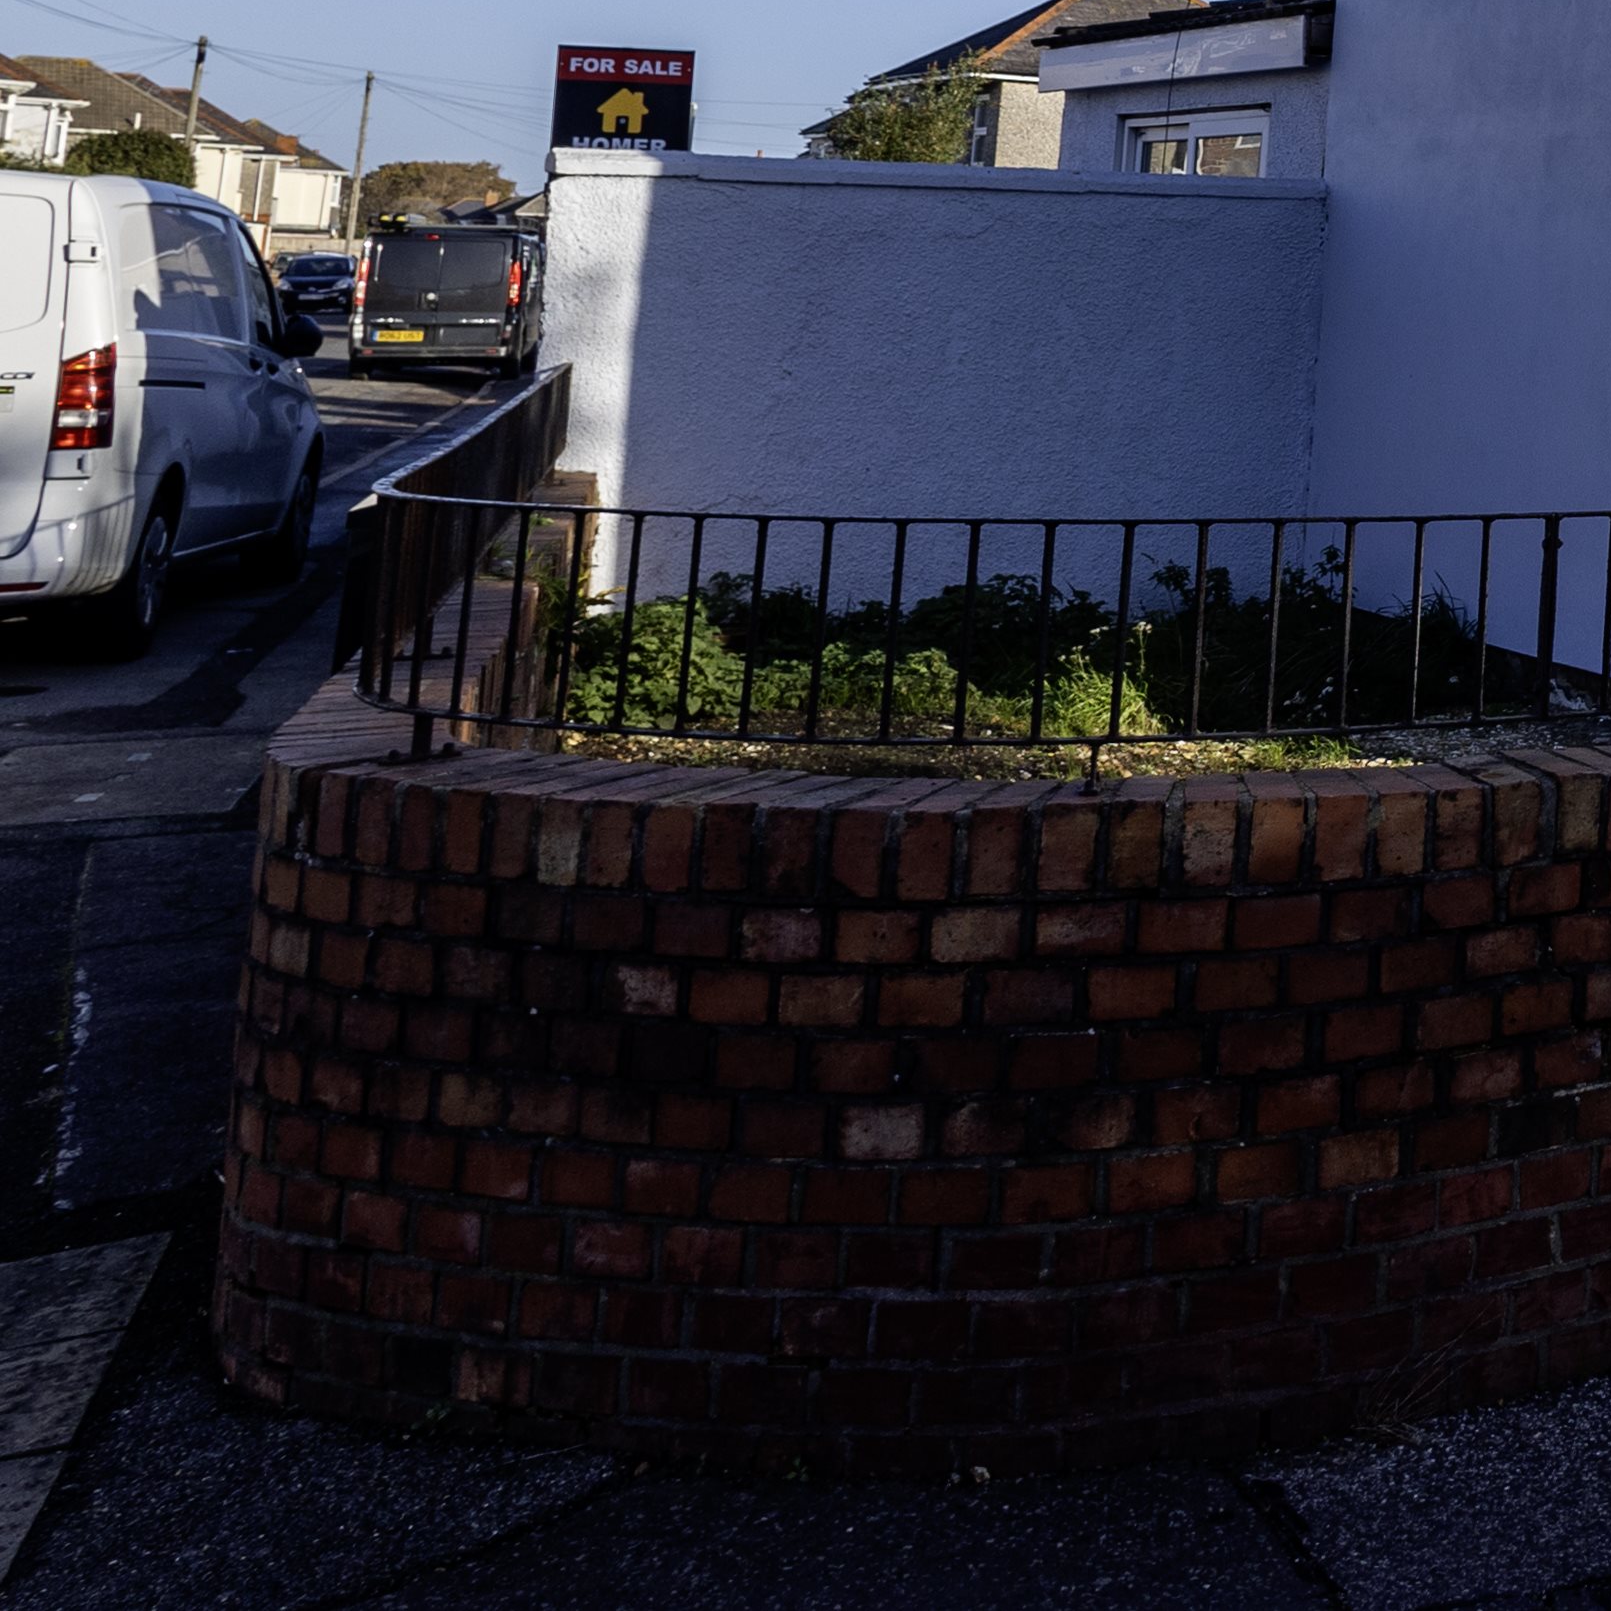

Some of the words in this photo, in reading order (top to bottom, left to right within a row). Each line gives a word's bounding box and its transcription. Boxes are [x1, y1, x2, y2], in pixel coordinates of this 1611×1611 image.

[569, 57, 615, 73] FOR
[624, 59, 683, 76] SALE
[572, 136, 667, 151] HOMER
